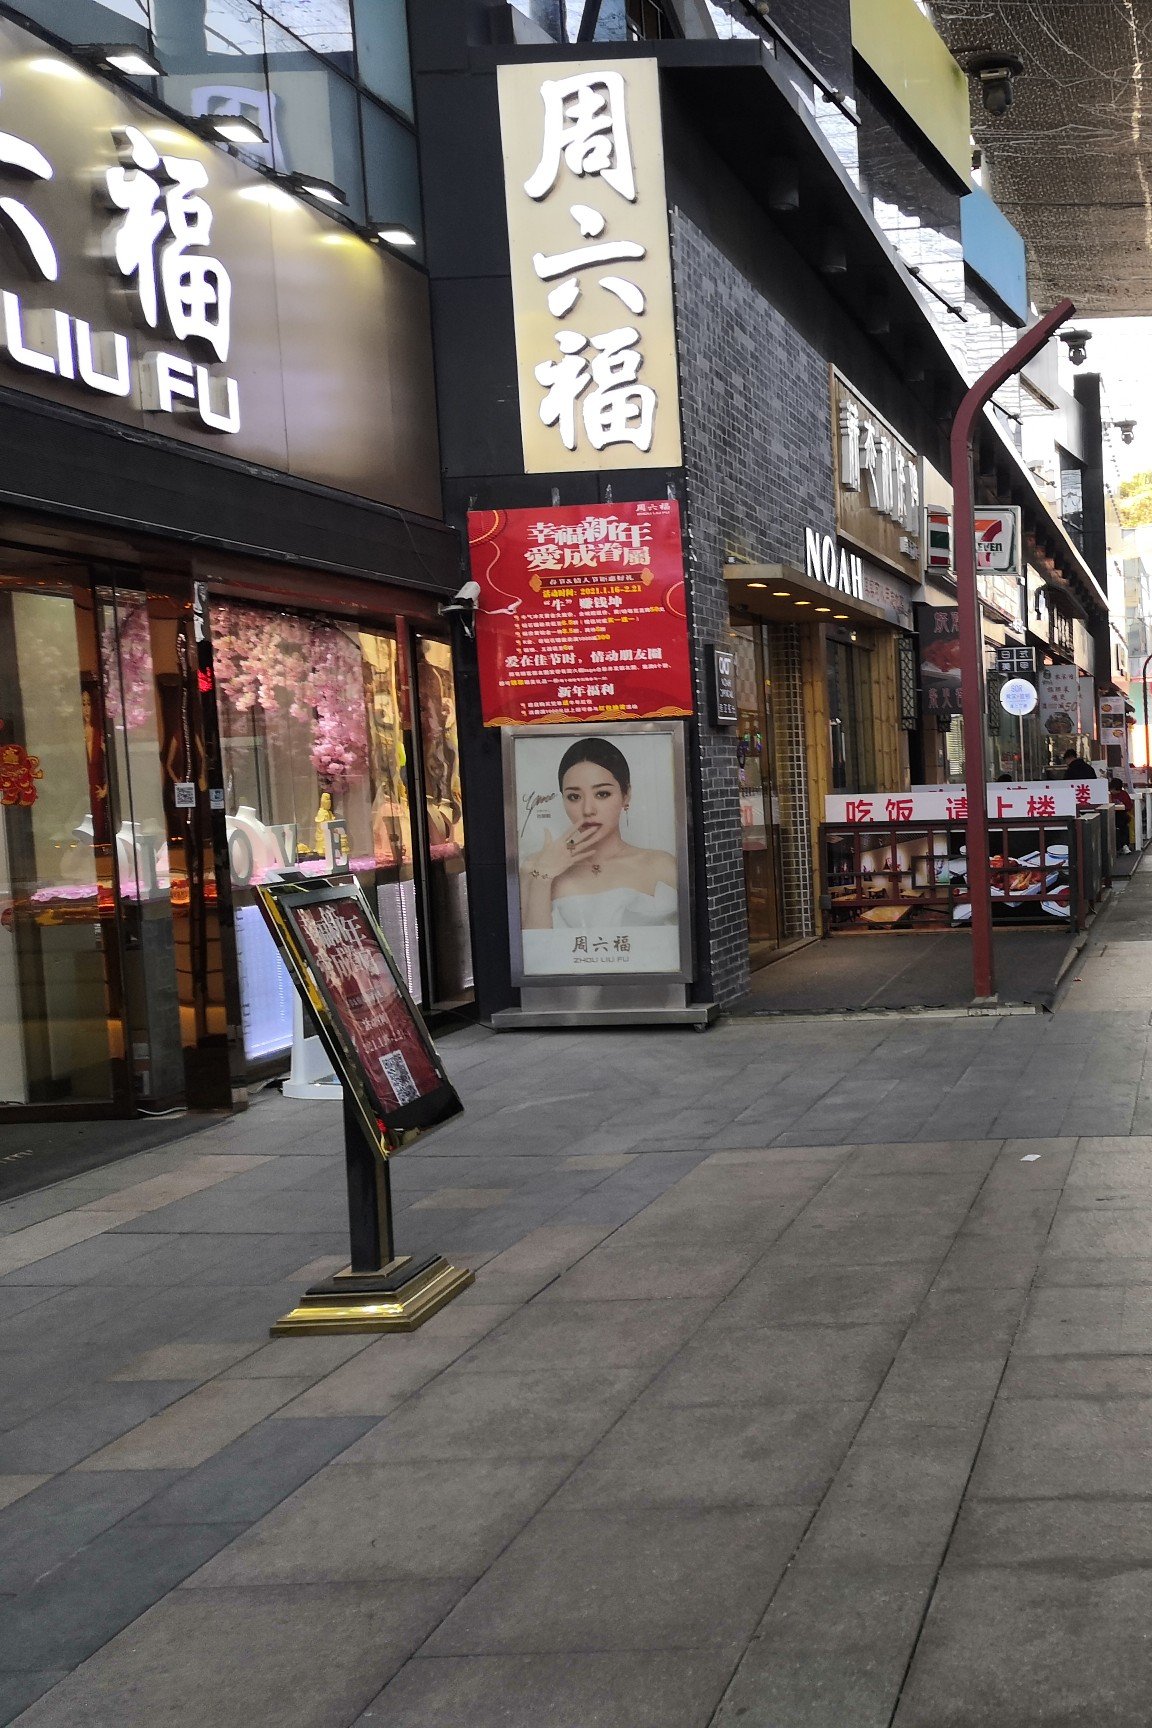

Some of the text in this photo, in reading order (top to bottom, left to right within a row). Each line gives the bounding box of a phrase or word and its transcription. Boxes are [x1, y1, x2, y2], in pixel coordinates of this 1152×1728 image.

[524, 70, 657, 452] 周六福
[2, 290, 240, 433] LIU FU
[636, 502, 671, 512] 周六福
[527, 516, 653, 547] 幸福新年
[805, 527, 863, 600] NOAH
[557, 683, 615, 698] 新年福利
[572, 934, 631, 953] 周六福
